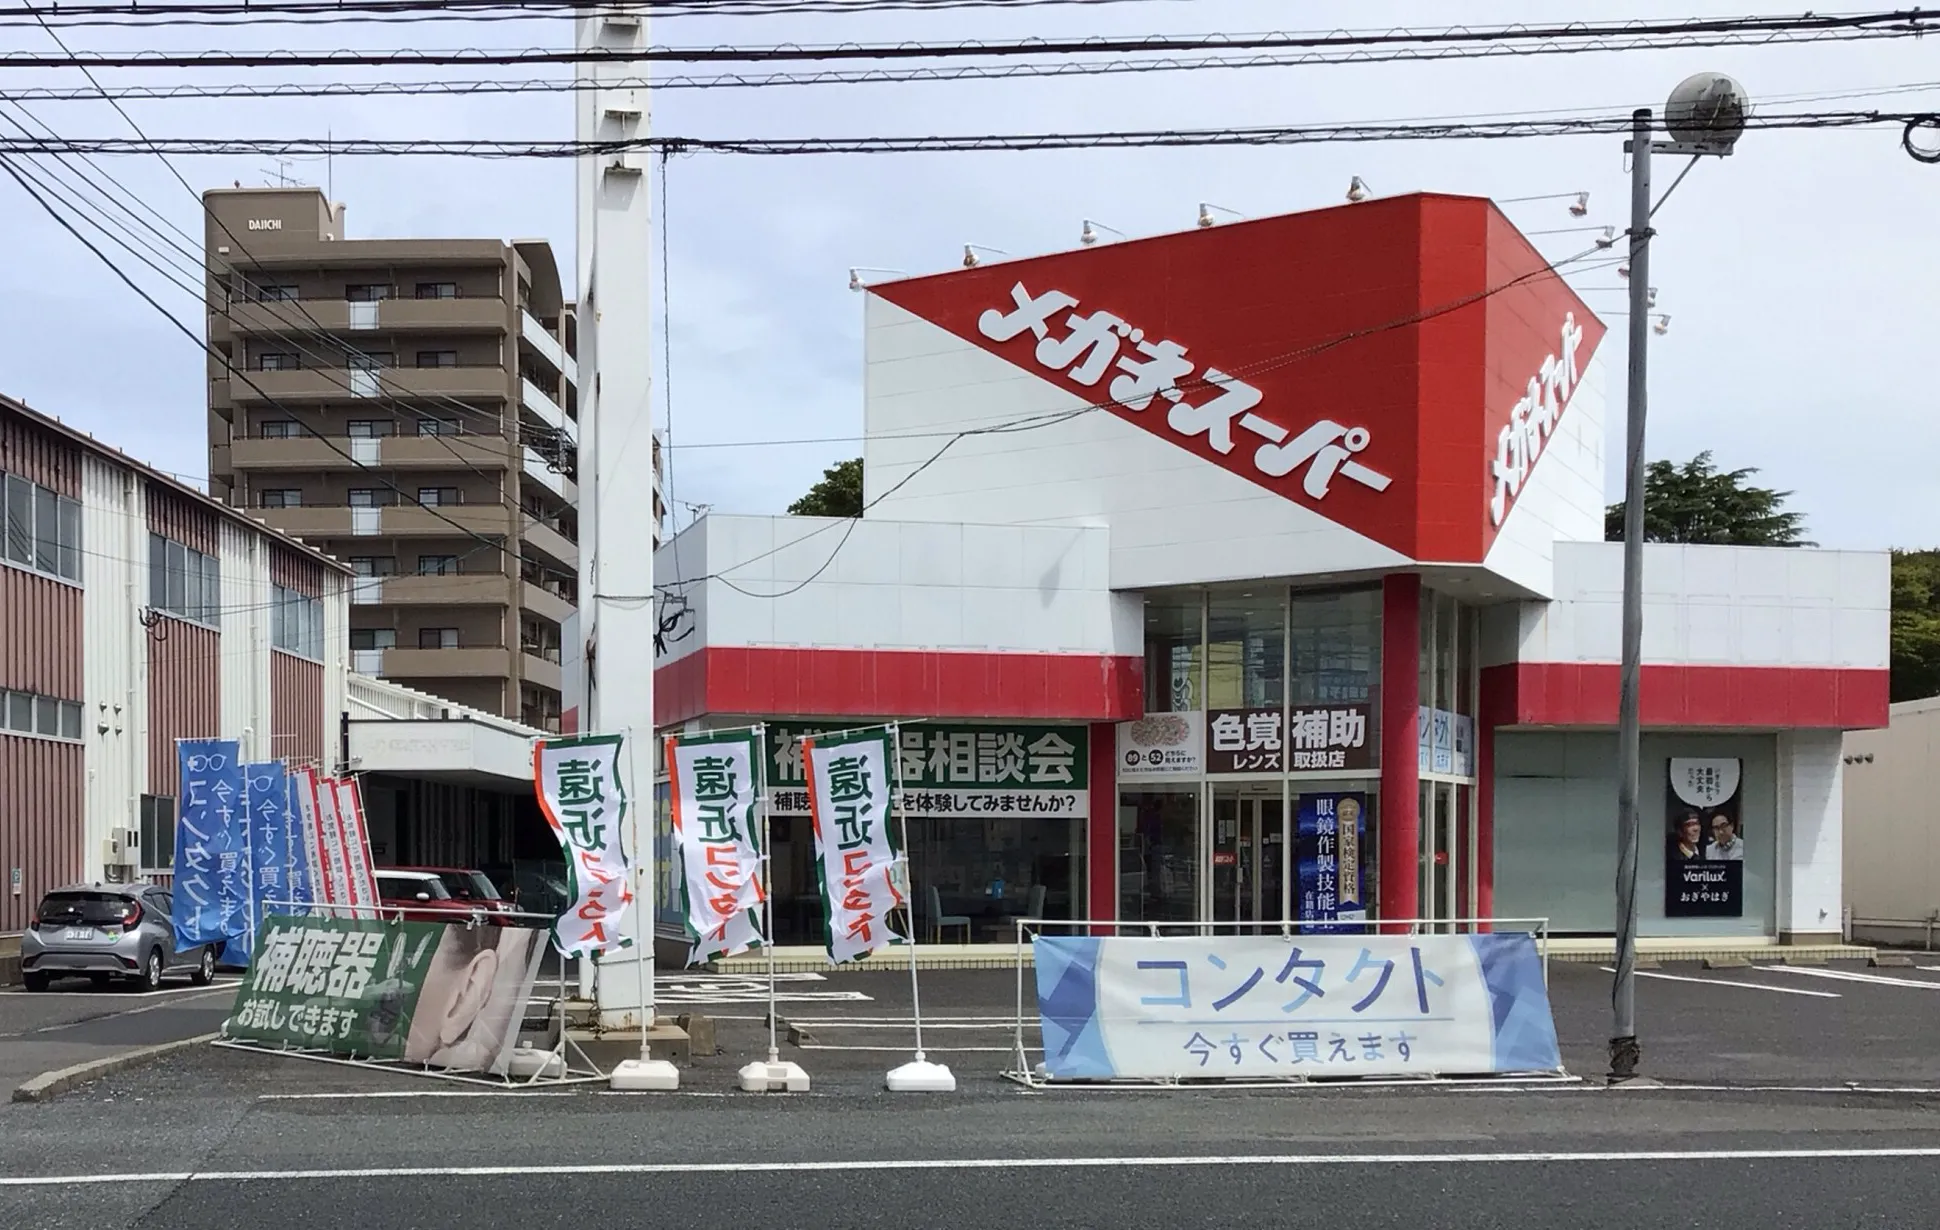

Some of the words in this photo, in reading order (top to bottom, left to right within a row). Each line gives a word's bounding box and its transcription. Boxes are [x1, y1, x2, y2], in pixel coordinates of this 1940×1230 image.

[248, 219, 282, 230] DAIICHI
[977, 281, 1393, 500] メガネスーパー
[1491, 311, 1582, 526] メガネスーパー
[1680, 891, 1730, 902] おぎやはぎ
[252, 925, 385, 999] 補聴器
[1137, 946, 1445, 1014] コンタクト
[236, 998, 358, 1039] お試しできます
[1183, 1030, 1418, 1067] 今すぐ買えます
